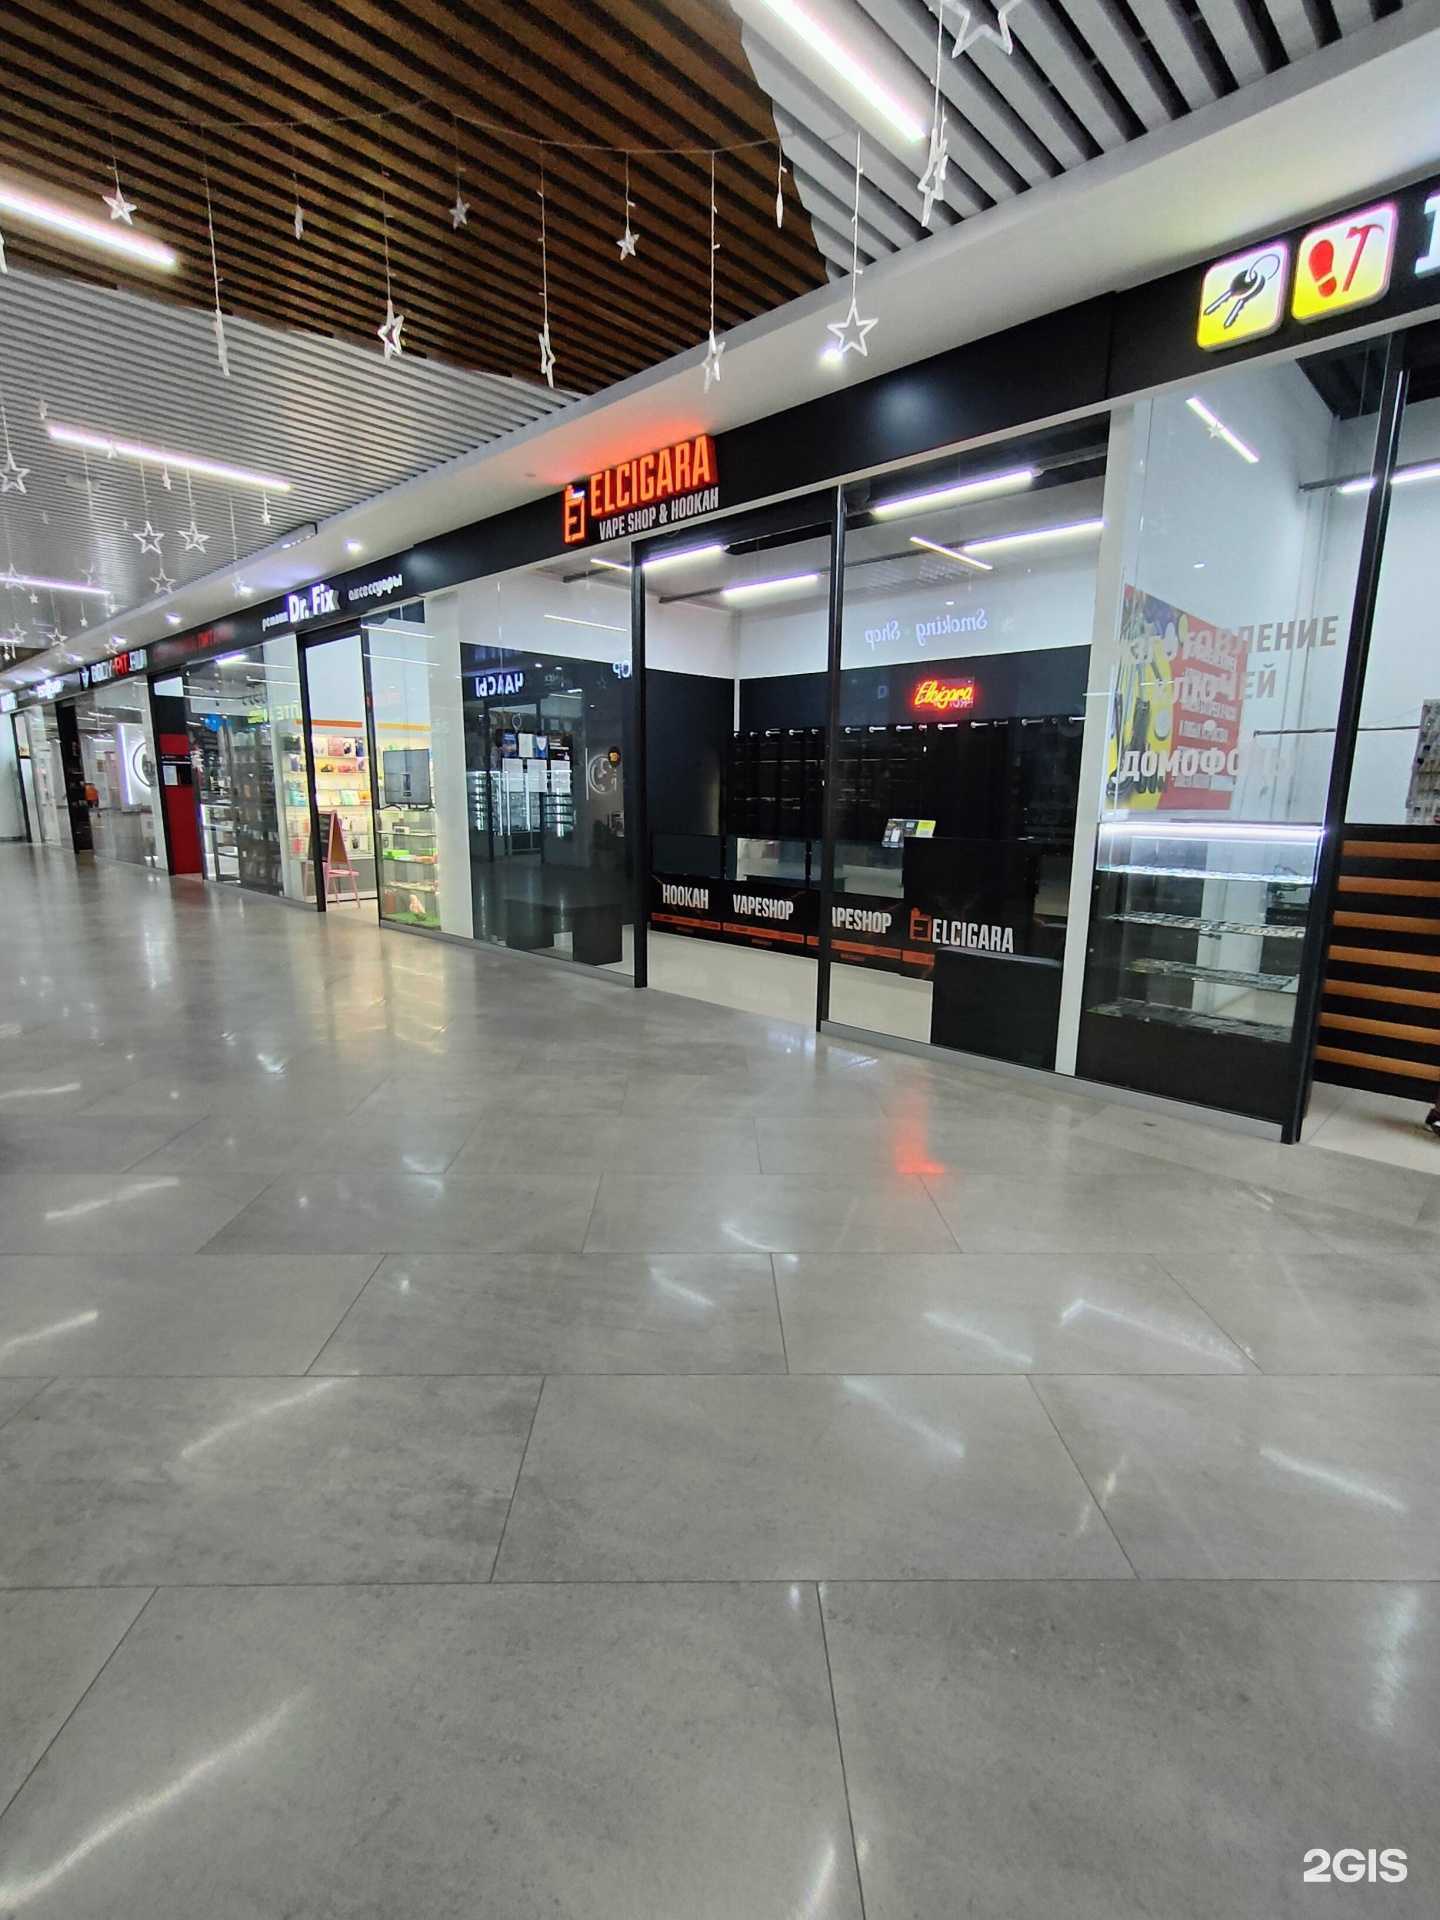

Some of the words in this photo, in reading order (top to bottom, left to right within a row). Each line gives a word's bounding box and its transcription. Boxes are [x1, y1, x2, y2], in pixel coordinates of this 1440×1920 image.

[590, 435, 712, 516] ELCIGARA
[599, 514, 626, 541] VAPE
[627, 505, 656, 533] SHOP
[658, 503, 669, 524] &
[671, 486, 719, 521] HOOKAH
[288, 594, 309, 624] Dr.
[311, 583, 336, 616] Fix
[662, 883, 709, 909] HOOKAH
[732, 894, 794, 921] VAPESHOP
[932, 918, 1014, 953] ELCIGARA
